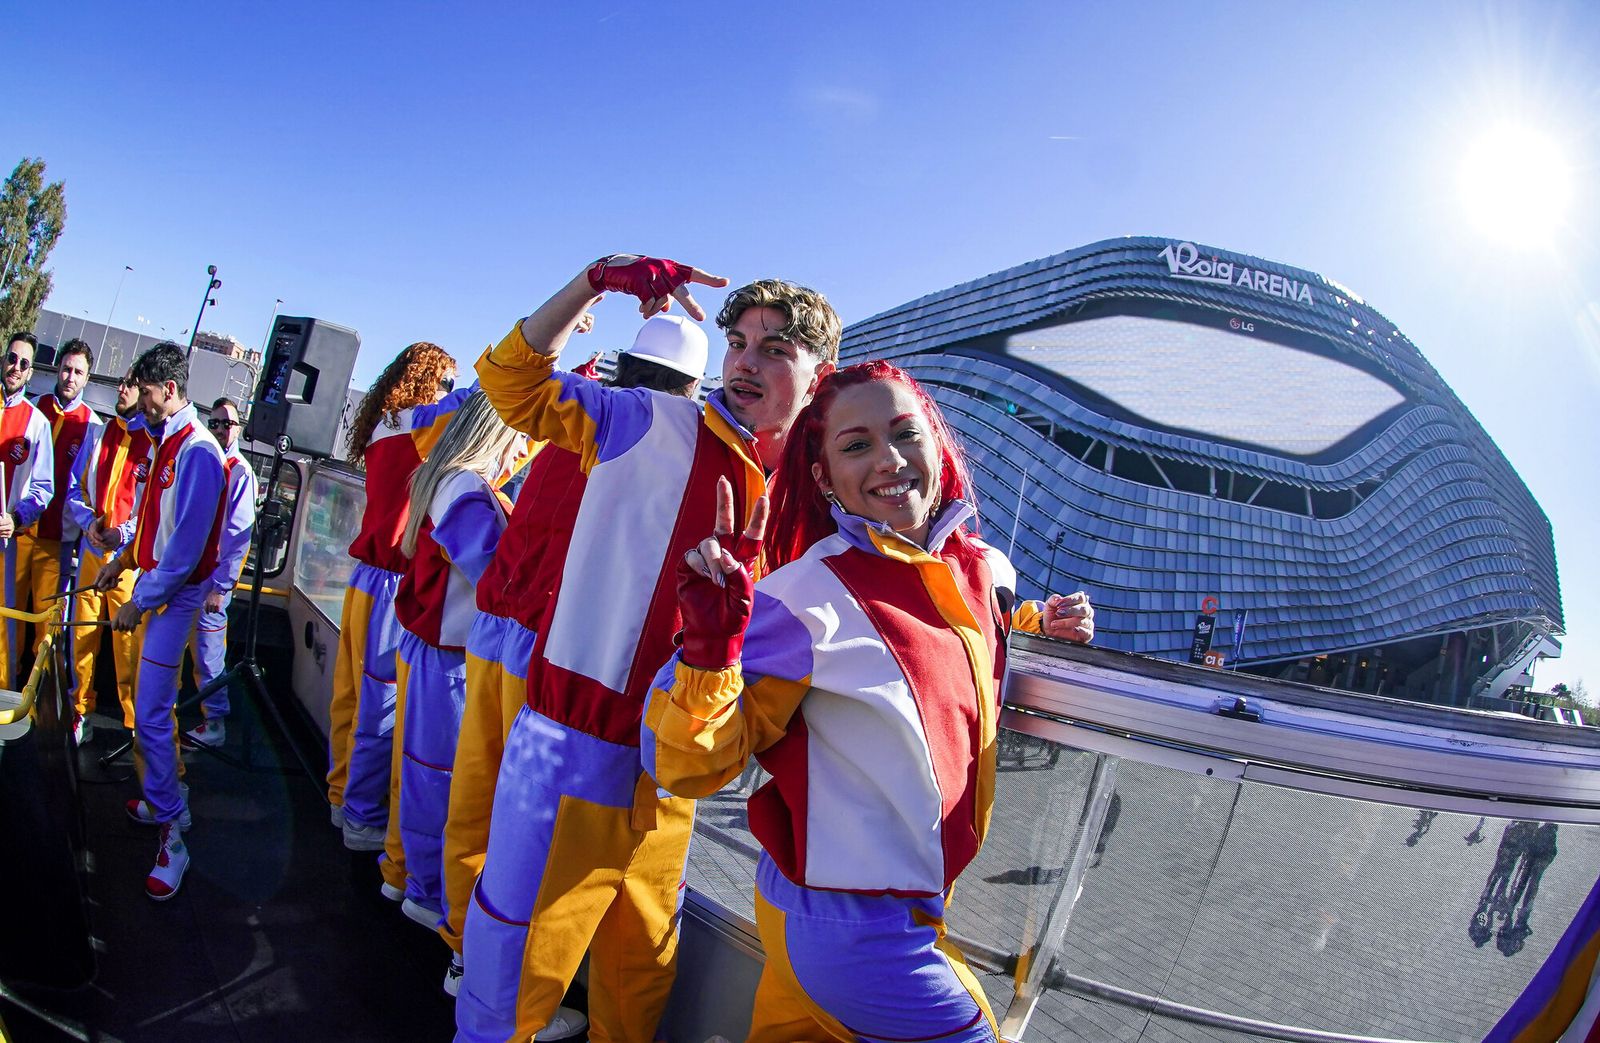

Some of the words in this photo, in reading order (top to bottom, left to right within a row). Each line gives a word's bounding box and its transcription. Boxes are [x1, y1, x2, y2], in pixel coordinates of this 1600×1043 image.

[1158, 242, 1234, 285] Roig
[1236, 267, 1314, 306] ARENA
[1241, 321, 1255, 332] LG
[1202, 596, 1217, 614] C
